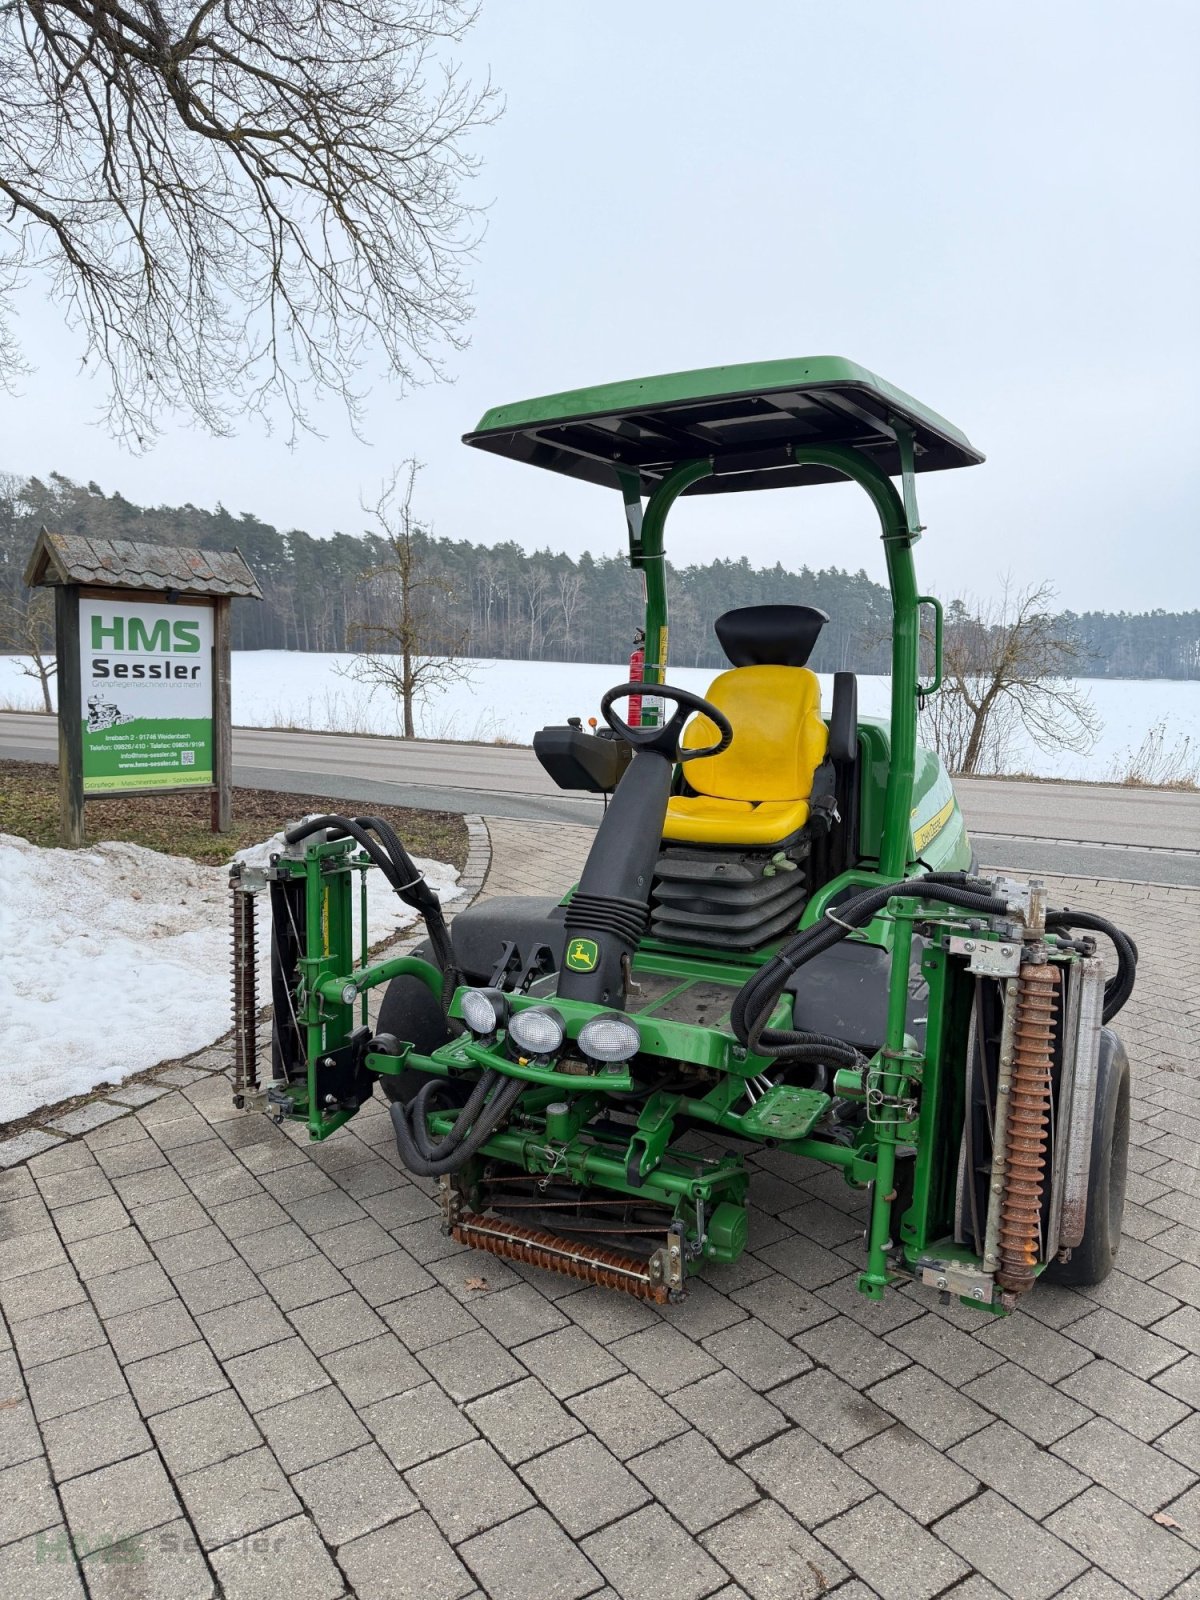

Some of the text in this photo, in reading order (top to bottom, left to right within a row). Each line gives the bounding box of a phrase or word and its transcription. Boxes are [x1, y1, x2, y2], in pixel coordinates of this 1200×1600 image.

[91, 615, 201, 653] HMS
[92, 659, 201, 680] Sessler
[118, 760, 179, 768] www.hms-sessler.de
